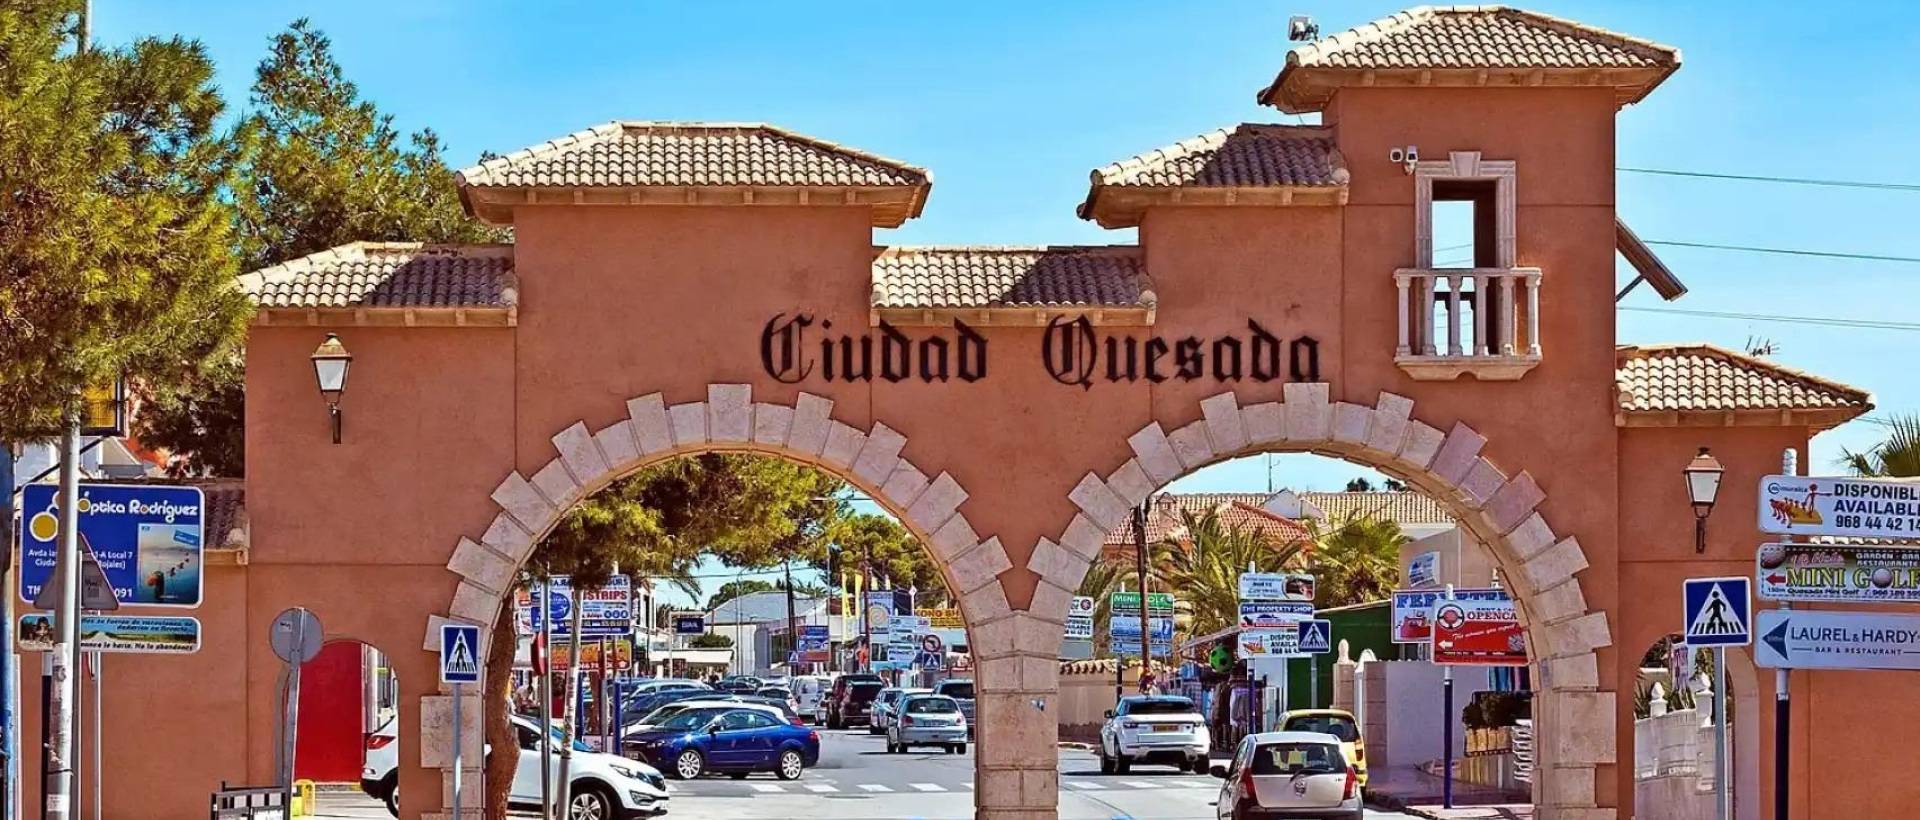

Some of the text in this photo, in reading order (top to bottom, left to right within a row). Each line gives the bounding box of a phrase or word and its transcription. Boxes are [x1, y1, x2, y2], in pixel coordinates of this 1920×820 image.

[761, 312, 1321, 391] Ciudad Quesada
[1836, 515, 1860, 528] 968
[1865, 516, 1882, 530] 44
[1886, 517, 1903, 531] 42
[35, 558, 57, 567] Ciuda
[1786, 567, 1920, 590] MINI GOLF
[1243, 605, 1313, 613] THE PROPERTY SHOP
[1467, 611, 1518, 620] OPENCA
[1791, 627, 1850, 642] LAUREL
[1852, 632, 1861, 643] &
[1862, 628, 1918, 644] HARDY
[1846, 648, 1902, 656] RESTAURANT
